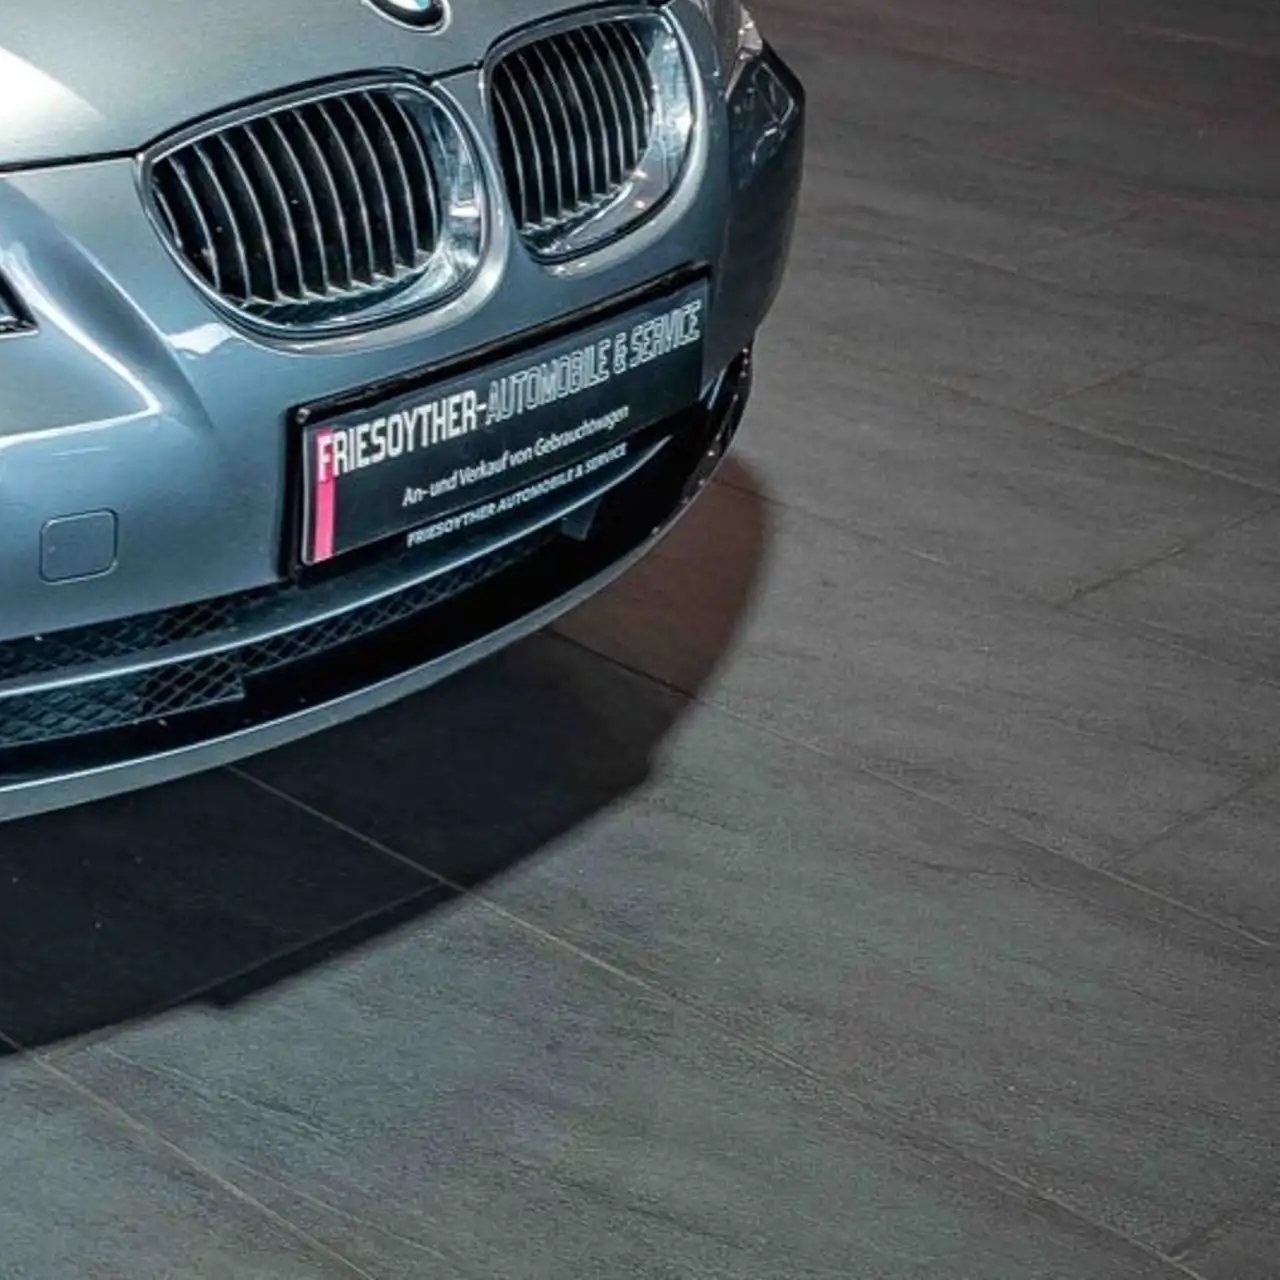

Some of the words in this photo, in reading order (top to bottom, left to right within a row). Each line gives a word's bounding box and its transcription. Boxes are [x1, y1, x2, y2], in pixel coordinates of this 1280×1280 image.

[317, 337, 612, 483] FRIESOYTHER-AUTOMOBILE
[613, 332, 629, 375] &
[630, 299, 702, 369] SERVICE
[429, 469, 458, 498] und
[459, 449, 510, 487] Verkauf
[509, 446, 533, 468] von
